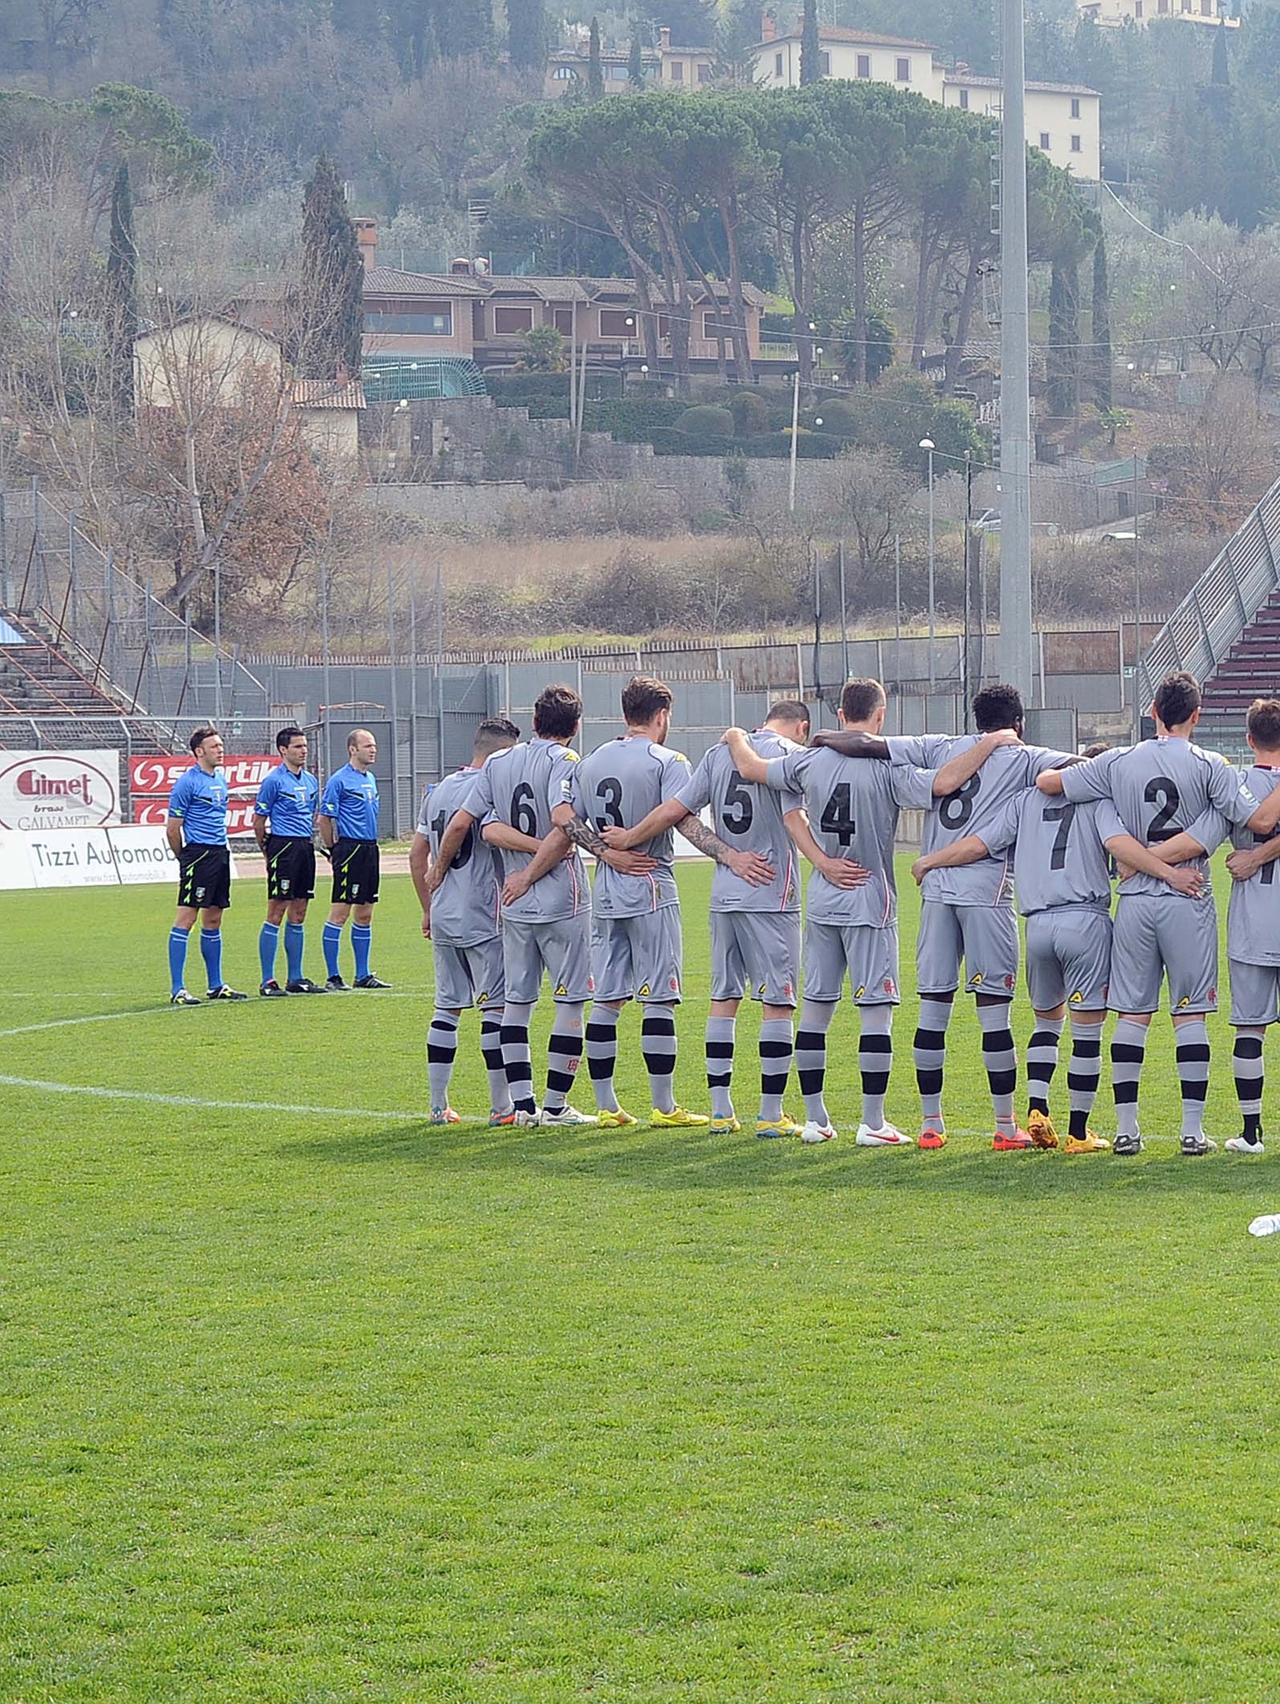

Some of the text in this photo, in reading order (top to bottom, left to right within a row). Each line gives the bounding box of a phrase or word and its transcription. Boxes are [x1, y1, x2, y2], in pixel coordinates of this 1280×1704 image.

[510, 782, 537, 838] 6
[596, 777, 623, 833] 3
[722, 770, 754, 835] 5
[820, 782, 856, 847] 4
[939, 770, 981, 831] 8
[1144, 776, 1184, 842] 2
[32, 843, 79, 867] Tizzi
[1042, 803, 1076, 870] 7
